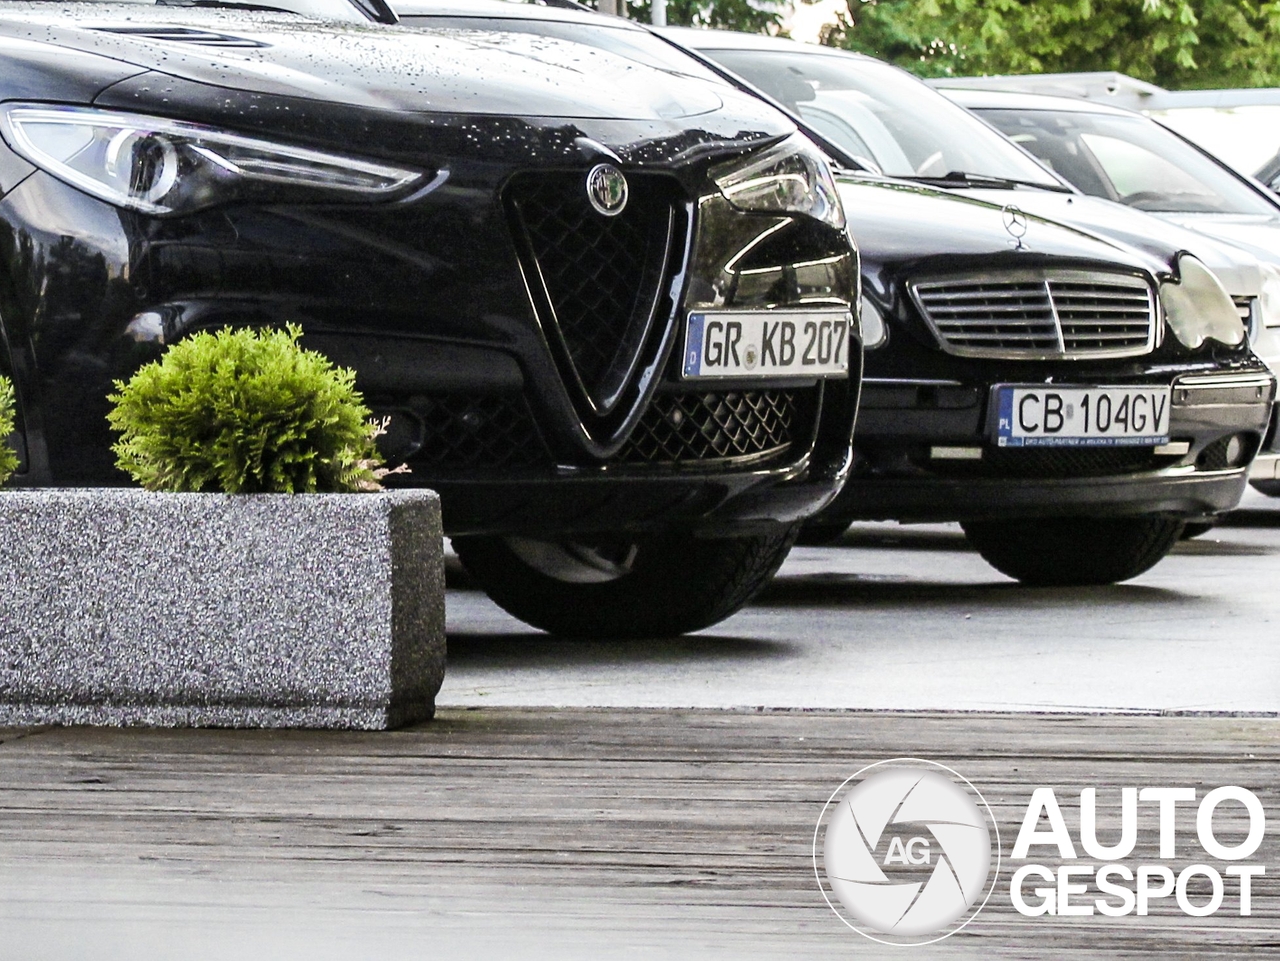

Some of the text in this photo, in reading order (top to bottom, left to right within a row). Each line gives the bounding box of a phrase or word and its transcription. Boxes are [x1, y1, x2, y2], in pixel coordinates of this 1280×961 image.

[704, 321, 847, 367] GR KB 207
[689, 351, 696, 365] D
[999, 418, 1010, 430] PL
[1018, 393, 1166, 433] CB 104GV
